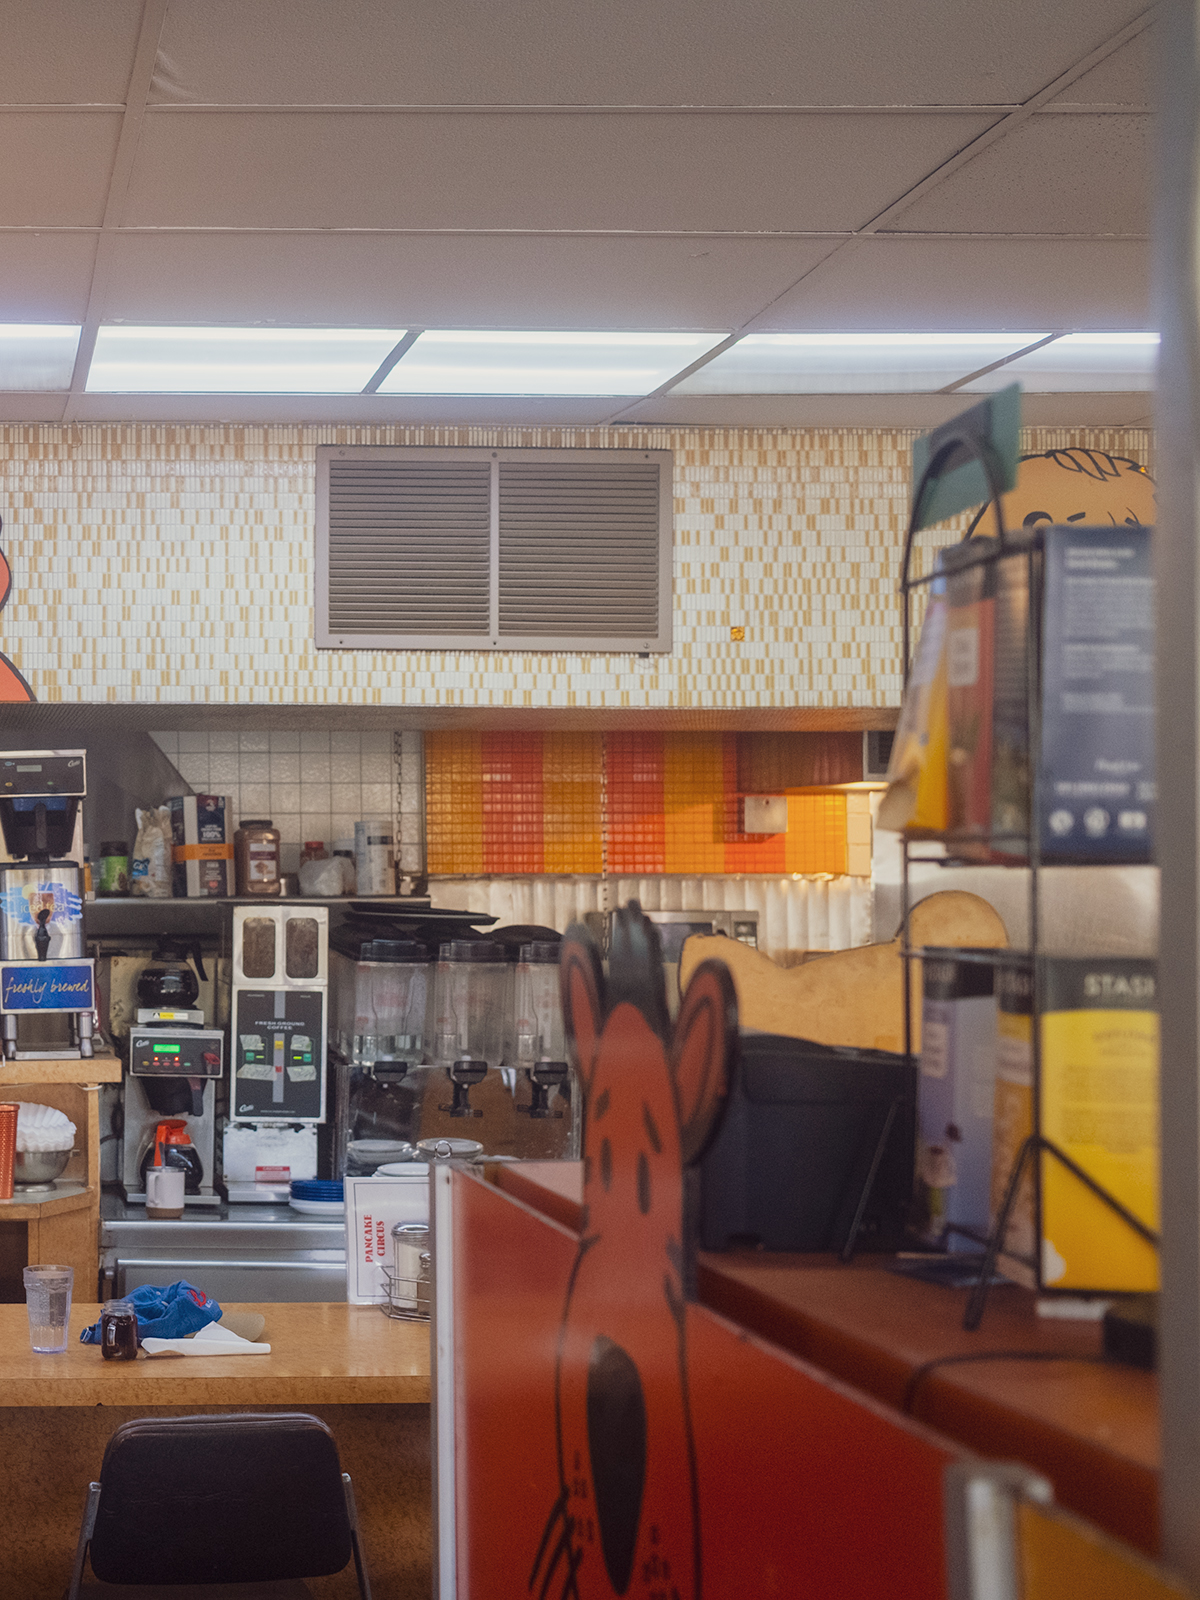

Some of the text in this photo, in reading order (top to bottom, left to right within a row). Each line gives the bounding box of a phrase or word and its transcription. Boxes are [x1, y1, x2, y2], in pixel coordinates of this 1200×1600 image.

[20, 902, 65, 913] iced tea
[5, 976, 90, 1004] freshly brewed
[363, 1214, 374, 1263] PANCAKE
[375, 1220, 386, 1257] CIRCUS
